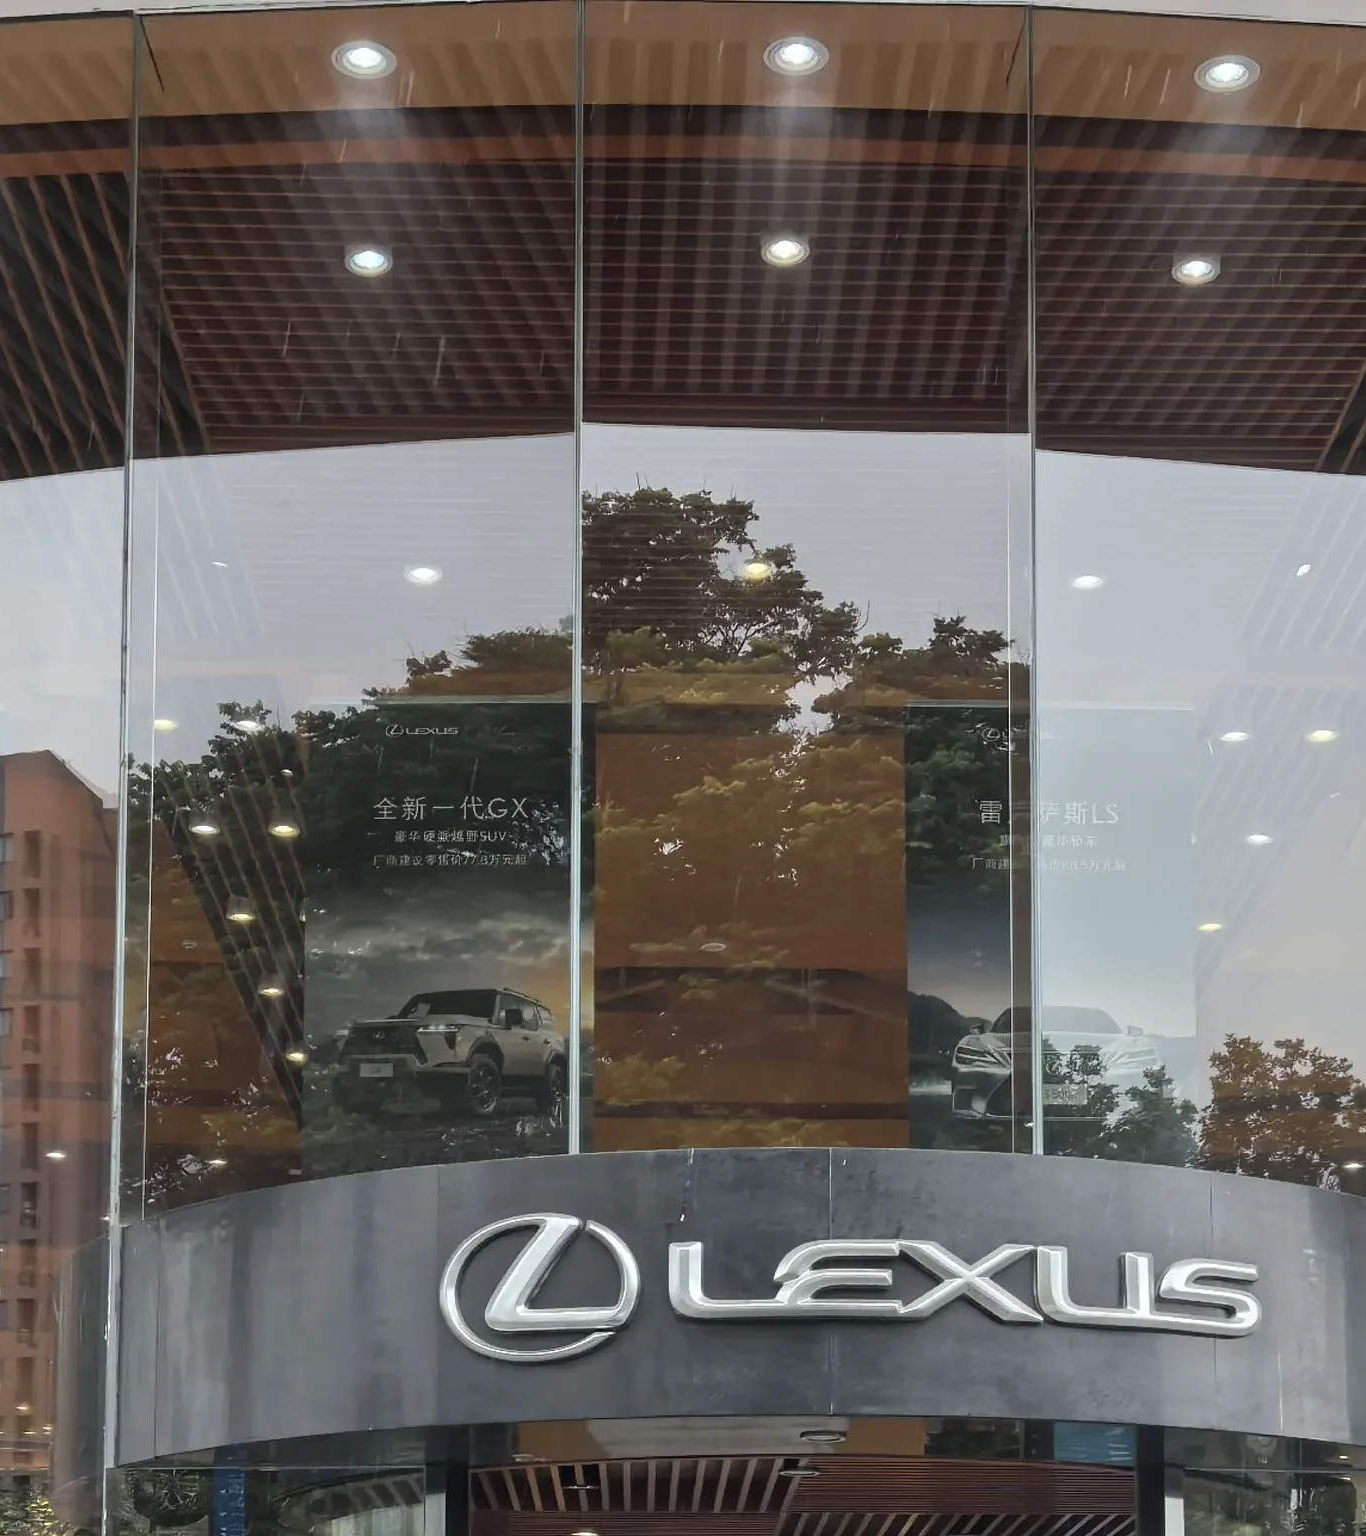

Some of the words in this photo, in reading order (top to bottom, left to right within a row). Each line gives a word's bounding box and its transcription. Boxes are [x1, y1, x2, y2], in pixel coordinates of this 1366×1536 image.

[405, 727, 459, 736] LEXUS
[373, 795, 529, 821] 全新一代GX
[979, 799, 1119, 825] 雷萨斯LS
[667, 1238, 1262, 1338] LEXUS
